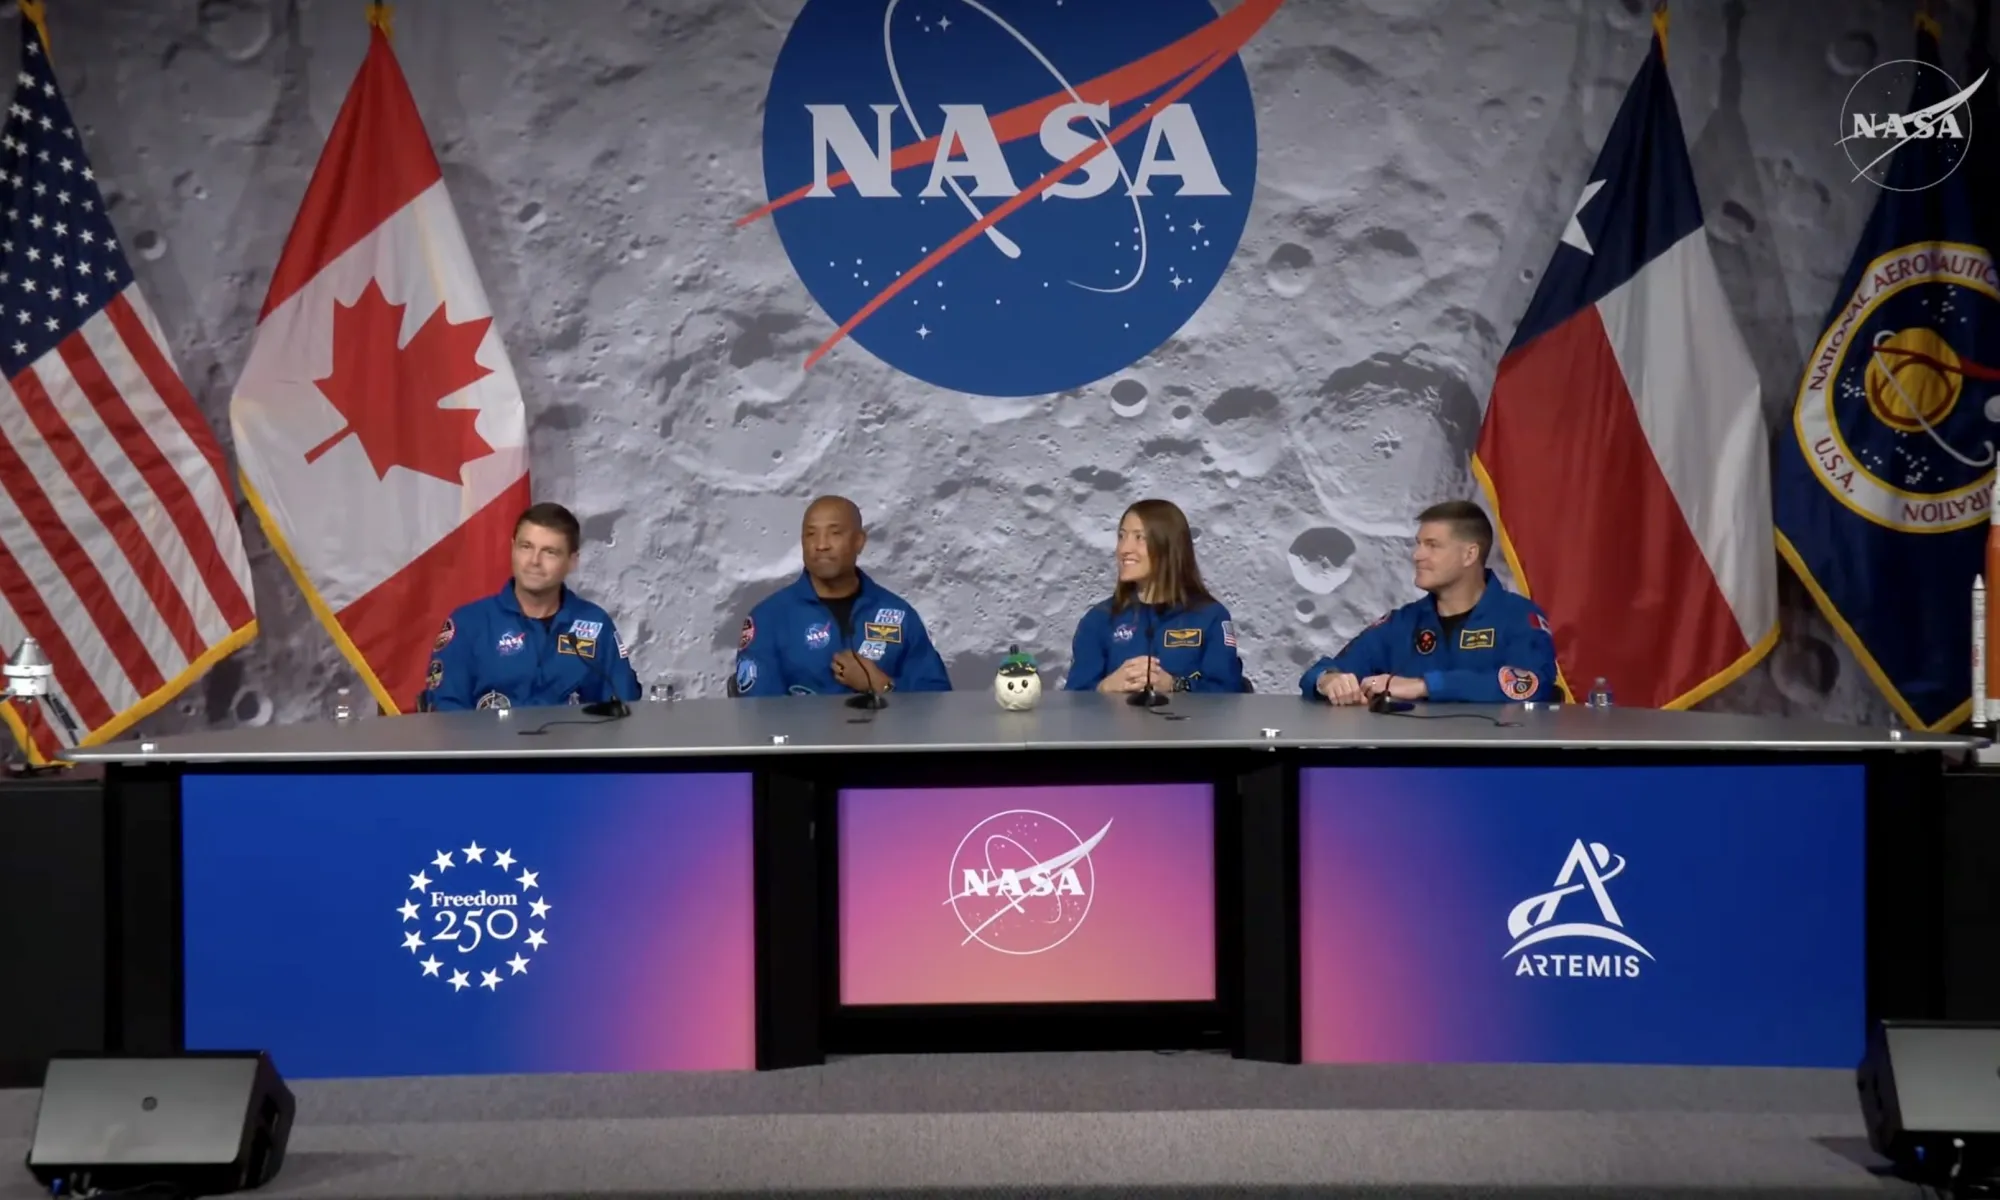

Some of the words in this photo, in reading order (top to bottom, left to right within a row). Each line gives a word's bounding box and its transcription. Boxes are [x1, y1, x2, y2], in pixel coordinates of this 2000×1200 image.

[803, 100, 1232, 202] NASA
[1808, 293, 1872, 391] NATIONAL
[1814, 436, 1854, 493] U.S.A.
[430, 889, 518, 908] Freedom
[961, 867, 1085, 897] NASA
[431, 908, 518, 953] 250
[1515, 953, 1640, 978] ARTEMIS
